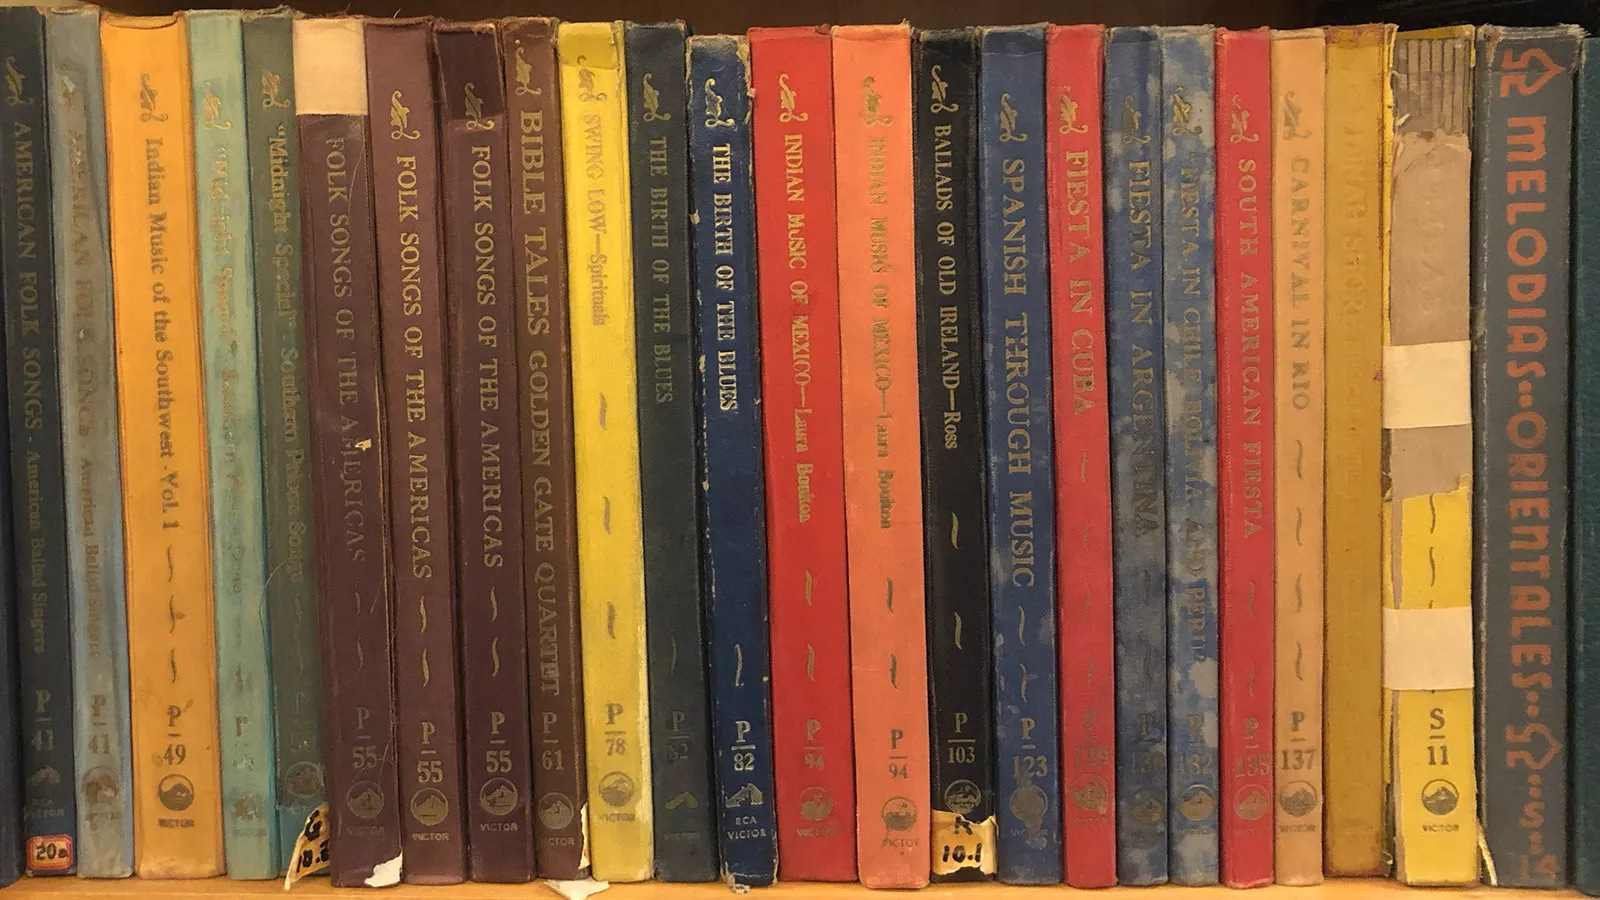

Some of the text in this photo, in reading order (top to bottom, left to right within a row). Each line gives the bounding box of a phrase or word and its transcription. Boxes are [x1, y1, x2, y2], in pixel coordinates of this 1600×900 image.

[583, 112, 605, 180] SWING
[145, 137, 166, 206] Indian
[324, 135, 349, 203] FOLK
[784, 133, 805, 202] INDIAN
[868, 136, 889, 206] INDIAN
[933, 124, 953, 210] BALLADS
[12, 120, 38, 259] AMERICAN
[1180, 166, 1201, 256] FIESTA
[149, 212, 170, 274] Music
[787, 212, 808, 269] MUSIC
[936, 221, 955, 246] OF
[329, 214, 353, 298] SONGS
[649, 136, 673, 405] THE BIRTH OF THE BLUES
[711, 142, 738, 411] THE BIRTH OF THE BLUES
[937, 255, 956, 295] OLD
[1182, 267, 1201, 295] IN
[152, 281, 171, 304] of
[790, 279, 808, 305] OF
[1065, 149, 1096, 417] FIESTA IN CUBA
[1290, 155, 1312, 411] CARNIVAL IN RIO
[18, 271, 41, 338] FOLK
[872, 284, 890, 308] OF
[154, 310, 173, 343] the
[335, 308, 356, 341] OF
[470, 145, 505, 568] FOLK SONGS OF THE AMERICAS
[1127, 160, 1159, 539] FIESTA IN ARGENTINA
[1237, 158, 1263, 540] SOUTH AMERICAN FIESTA
[336, 350, 359, 405] THE
[395, 155, 434, 579] FOLK SONGS OF THE AMERICAS
[1002, 158, 1036, 588] SPANISH THROUGH MUSIC
[22, 347, 44, 430] SONGS
[155, 349, 176, 458] Southwest
[519, 109, 560, 696] BIBLE TALES GOLDEN GATE QUARTET
[26, 450, 44, 531] American
[30, 593, 49, 653] Singers
[35, 689, 52, 713] P
[167, 705, 182, 727] P
[355, 706, 371, 730] P
[490, 711, 506, 734] P
[541, 711, 558, 734] P
[605, 703, 624, 725] P
[671, 710, 686, 733] P
[954, 712, 969, 733] P
[1187, 714, 1204, 736] P
[1290, 711, 1306, 732] P
[1429, 708, 1446, 730] S
[31, 728, 54, 751] 41
[420, 721, 436, 745] P
[734, 720, 752, 743] P
[805, 718, 822, 741] P
[890, 729, 904, 750] P
[1020, 717, 1036, 740] P
[164, 744, 187, 766] 49
[352, 745, 378, 769] 55
[605, 738, 626, 756] 78
[947, 746, 976, 764] 103
[1427, 745, 1449, 766] 11
[486, 750, 513, 774] 55
[541, 749, 564, 771] 61
[733, 753, 755, 771] 82
[888, 763, 909, 780] 94
[1012, 756, 1048, 777] 123
[1281, 749, 1316, 770] 137
[417, 760, 444, 784] 55
[158, 818, 195, 829] VICTOR
[480, 822, 518, 832] VICTOR
[735, 816, 757, 825] RCA
[1422, 823, 1460, 833] VICTOR
[727, 828, 767, 840] VICTOR
[943, 843, 982, 863] 10.1
